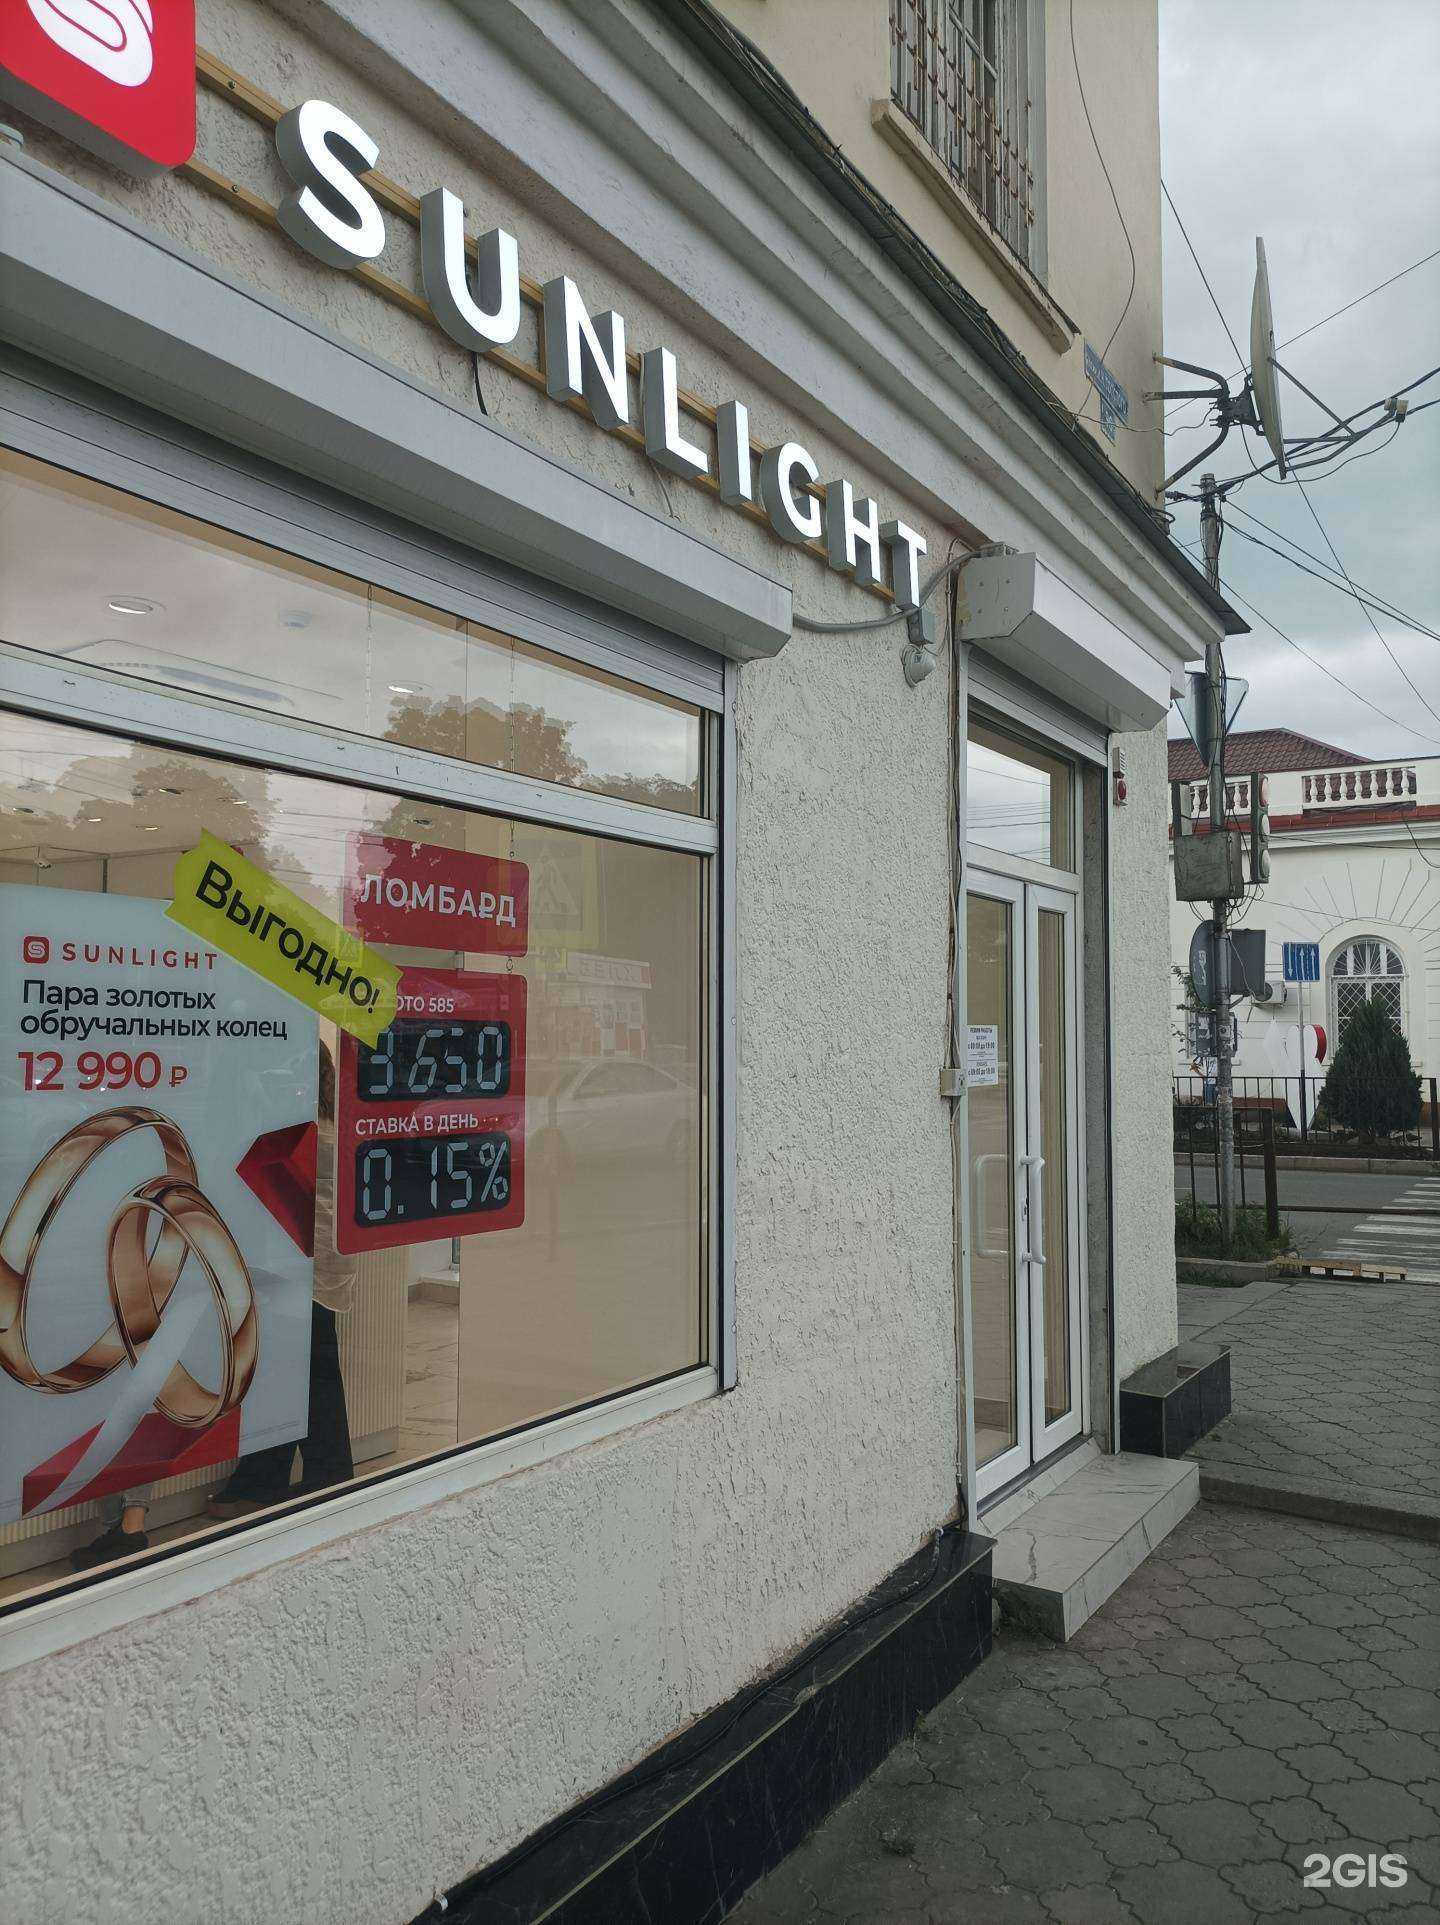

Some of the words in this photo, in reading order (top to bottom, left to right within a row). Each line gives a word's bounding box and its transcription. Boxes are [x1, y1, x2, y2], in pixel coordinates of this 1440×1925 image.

[277, 100, 927, 609] SUNLIGHT
[62, 943, 218, 970] SUNLIGHT
[23, 979, 99, 1010] Пара
[105, 987, 217, 1010] золотых
[429, 997, 455, 1013] 585
[20, 1009, 211, 1041] обручальных
[216, 1019, 288, 1041] колец
[18, 1051, 64, 1091] 12
[77, 1051, 162, 1091] 990
[355, 1114, 419, 1135] СТАВКА
[424, 1115, 434, 1131] В
[437, 1113, 479, 1133] ДЕНЬ
